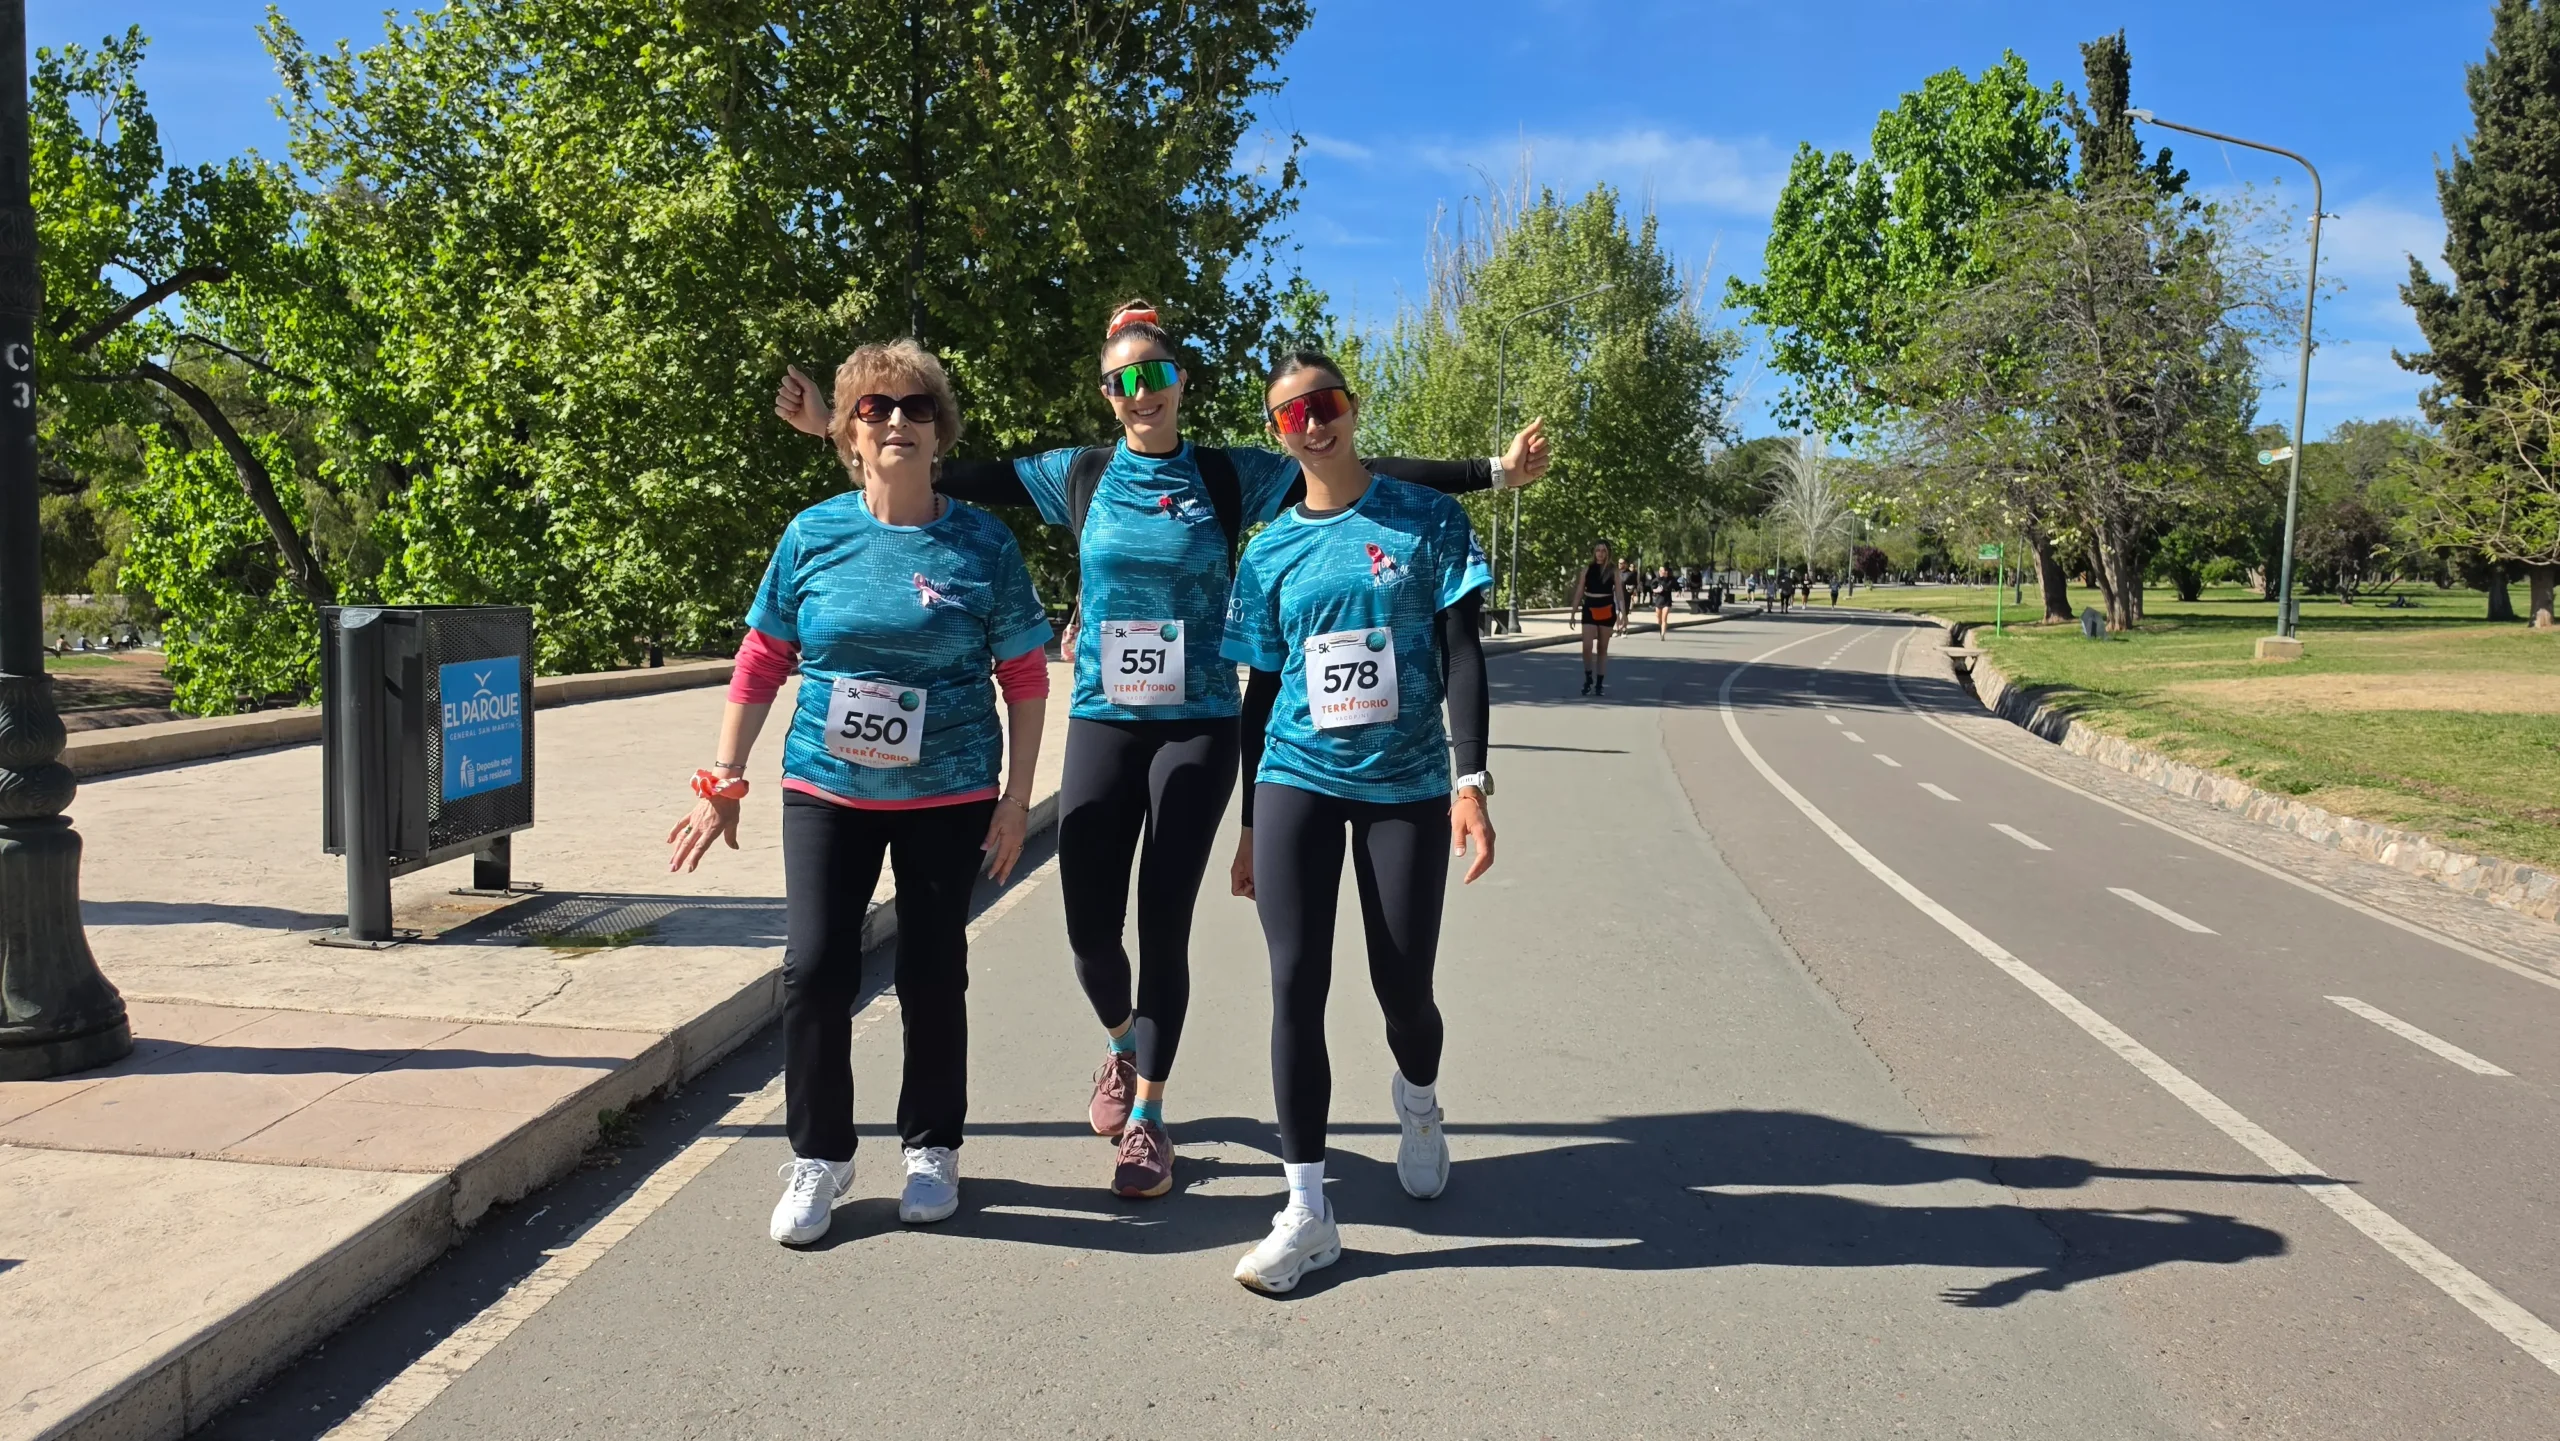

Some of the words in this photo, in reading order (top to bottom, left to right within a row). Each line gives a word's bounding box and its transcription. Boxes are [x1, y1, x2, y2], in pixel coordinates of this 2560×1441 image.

[6, 343, 29, 371] C
[12, 382, 30, 409] 3
[1120, 648, 1166, 674] 551
[1113, 679, 1176, 692] TERRITORIO
[1323, 660, 1379, 693] 578
[444, 703, 460, 729] EL
[462, 692, 519, 724] PARQUE
[1321, 696, 1389, 714] TERRITORIO
[449, 729, 477, 741] GENERAL
[478, 726, 491, 735] SAN
[840, 710, 908, 745] 550
[839, 746, 909, 762] TERRITORIO
[478, 774, 489, 783] sus
